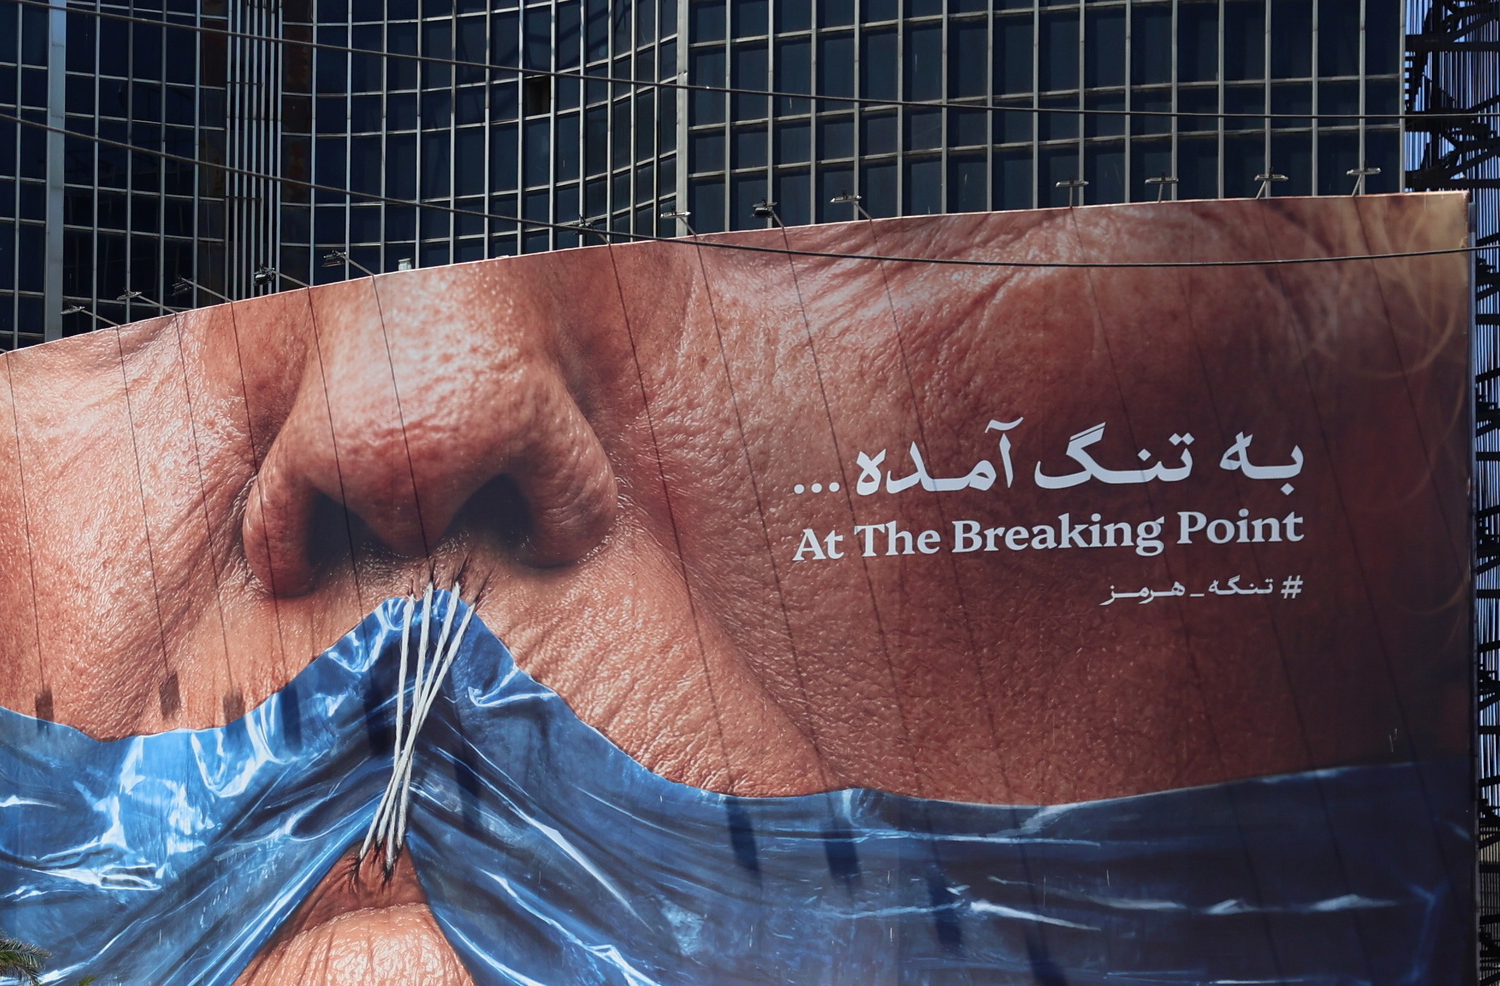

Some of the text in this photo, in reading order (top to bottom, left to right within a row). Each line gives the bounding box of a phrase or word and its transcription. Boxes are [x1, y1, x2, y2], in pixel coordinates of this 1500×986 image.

[1034, 422, 1196, 490] تنگ
[1219, 431, 1304, 496] به
[792, 508, 1305, 561] At The Breaking Point
